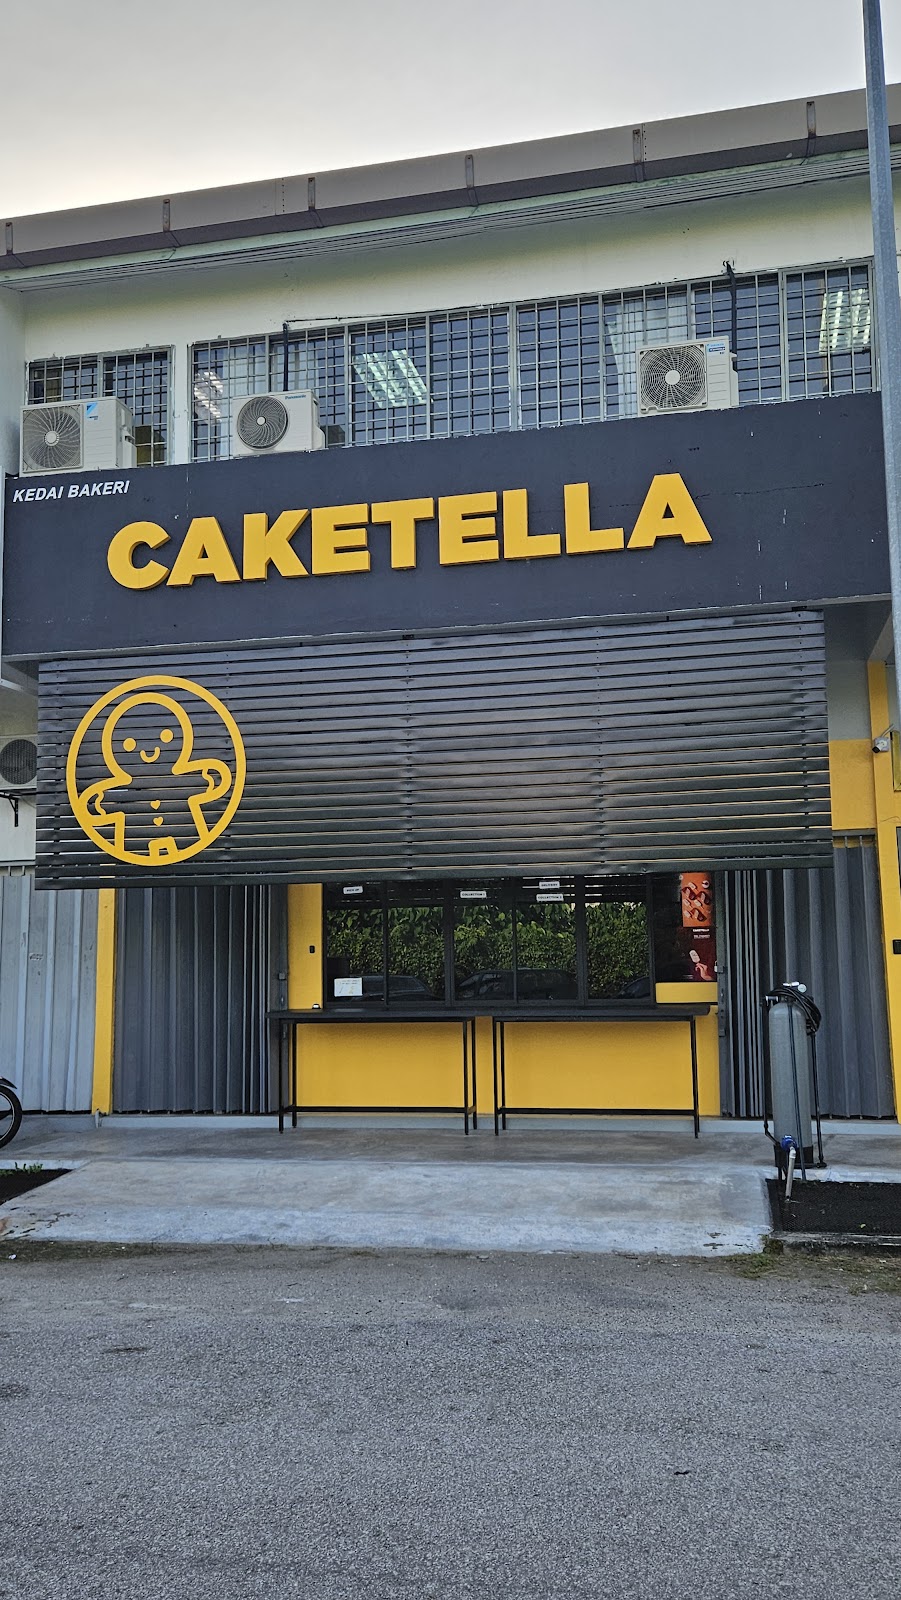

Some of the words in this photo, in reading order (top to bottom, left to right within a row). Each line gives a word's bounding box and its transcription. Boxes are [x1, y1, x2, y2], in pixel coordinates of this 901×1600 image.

[13, 486, 64, 502] KEDAI
[67, 480, 130, 498] BAKERI
[107, 473, 712, 590] CAKETELLA
